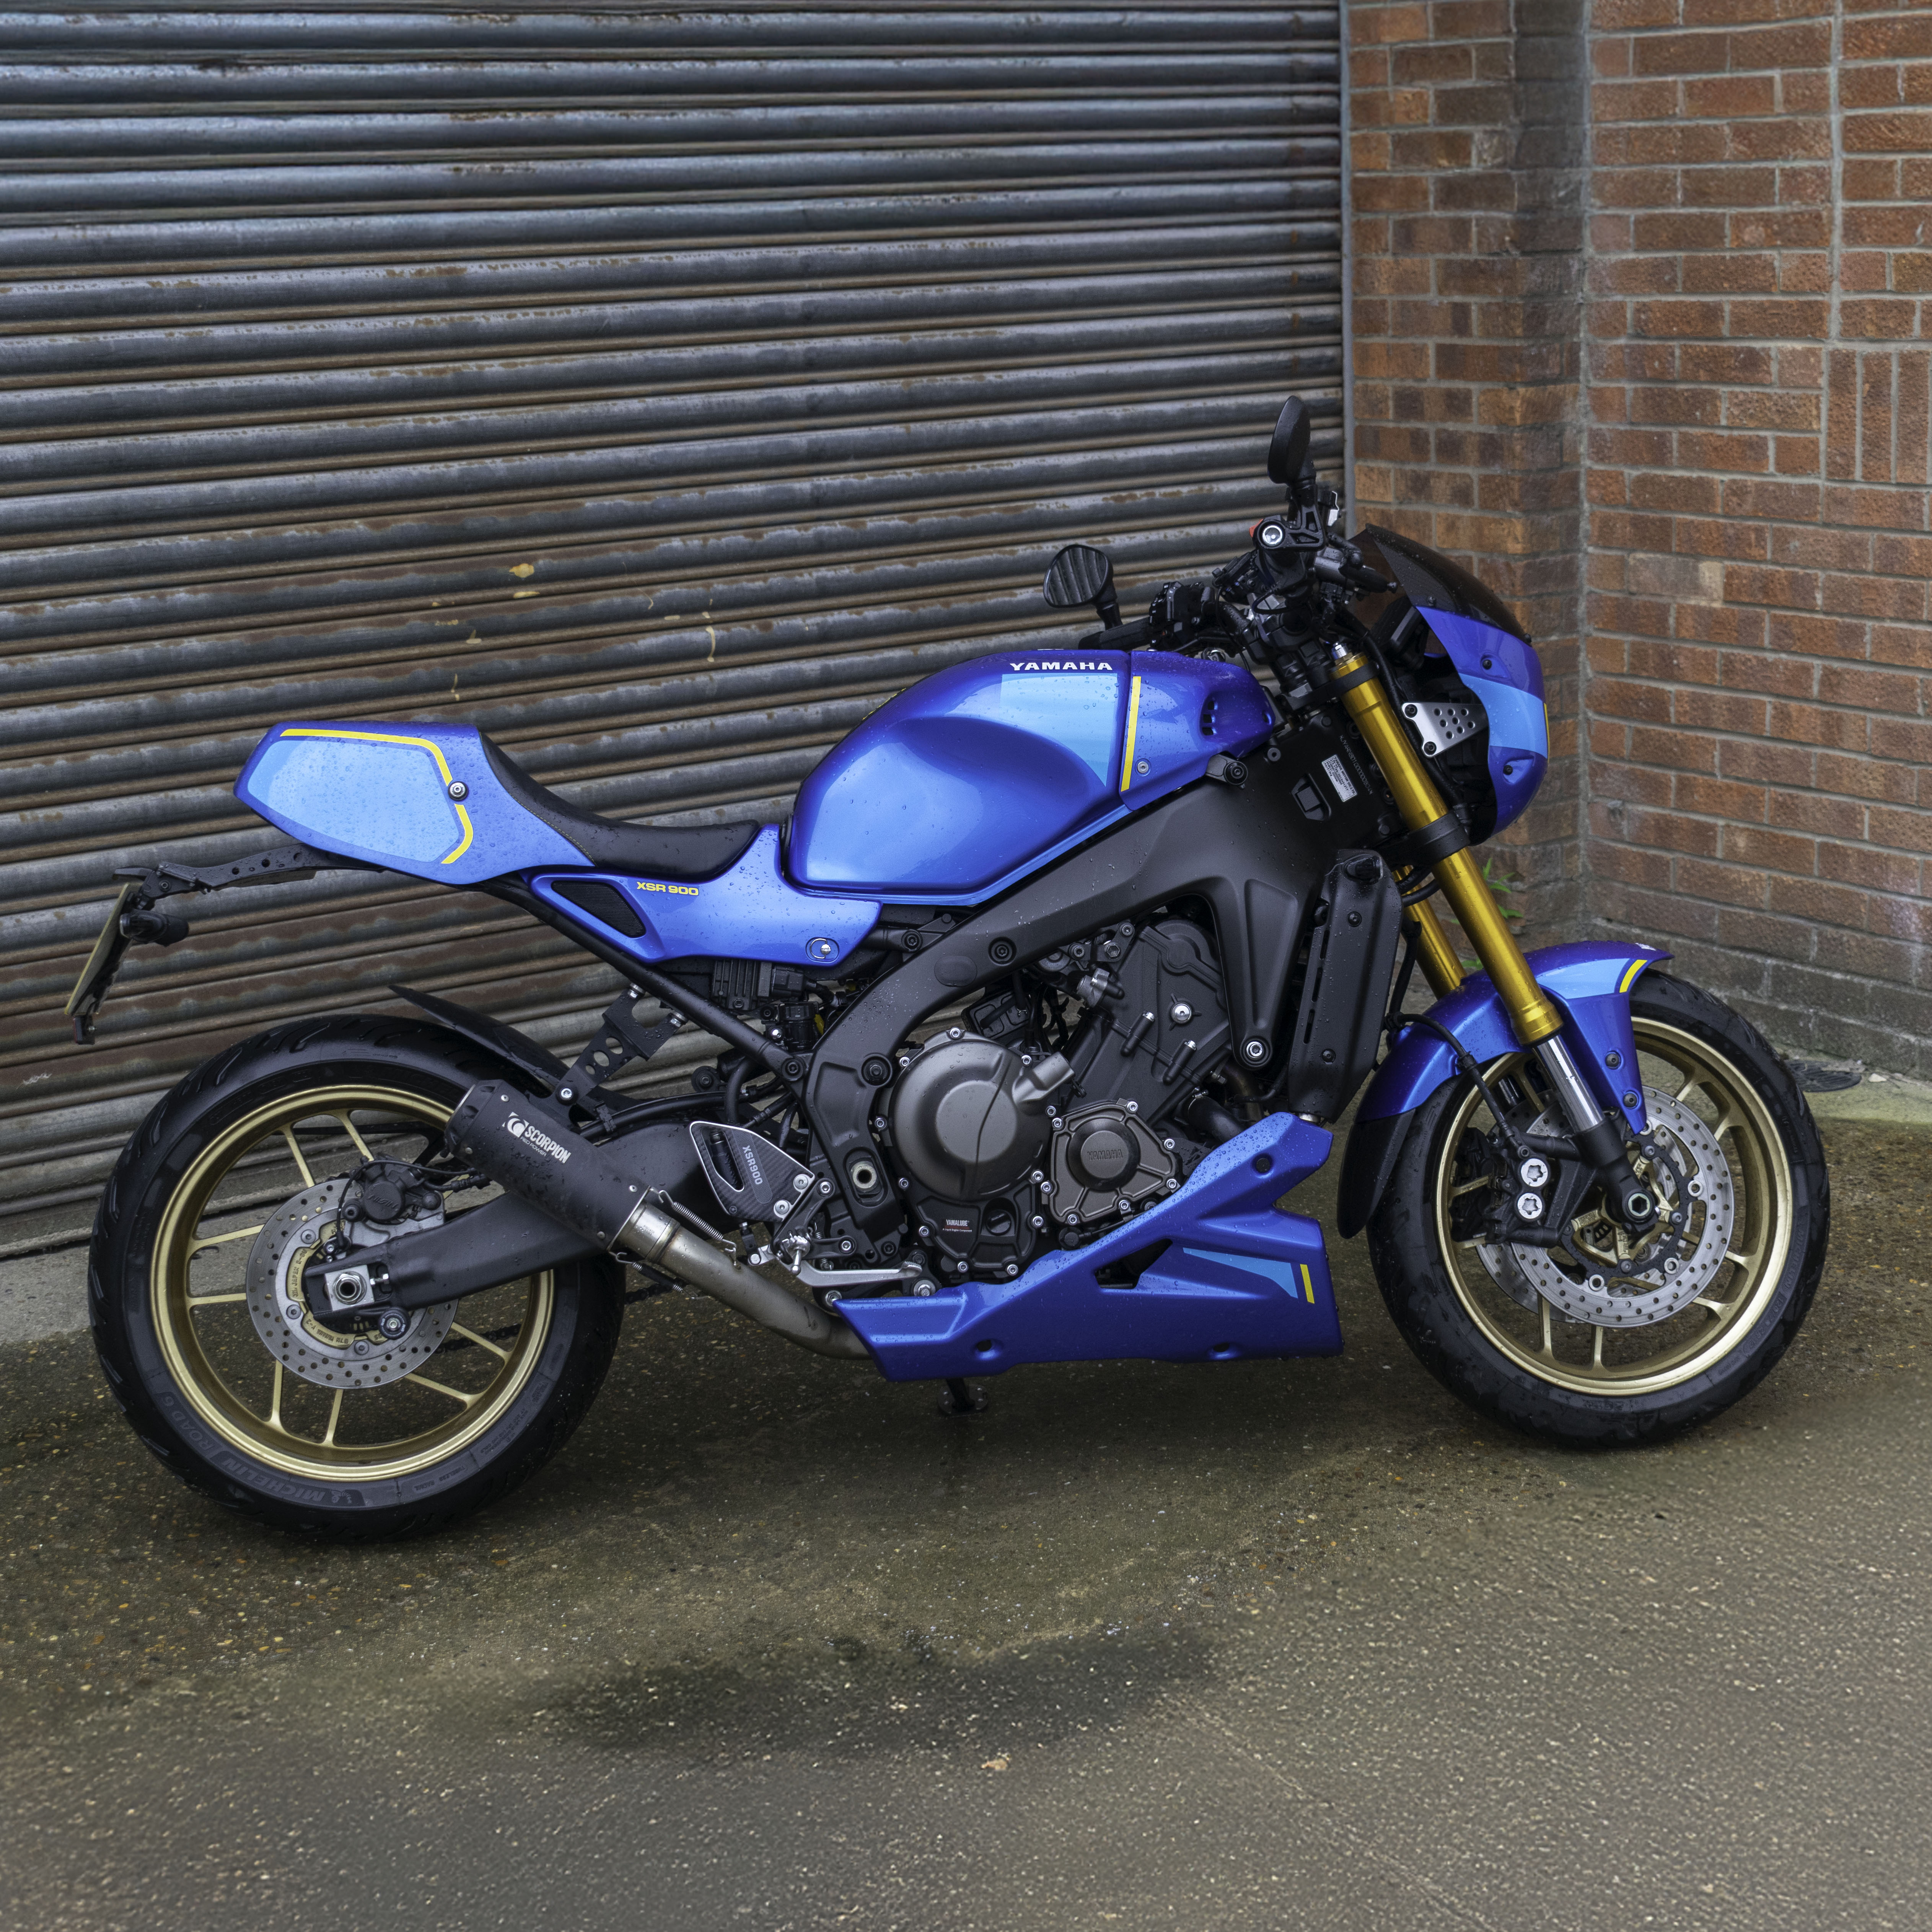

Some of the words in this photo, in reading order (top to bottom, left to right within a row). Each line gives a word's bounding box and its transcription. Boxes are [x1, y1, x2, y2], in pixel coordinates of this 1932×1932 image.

[1010, 662, 1113, 670] YAMAHA
[1334, 756, 1342, 770] YAMAHA
[1341, 771, 1349, 782] MOTOR
[637, 881, 666, 892] XSR
[668, 885, 699, 896] 900
[520, 1136, 531, 1145] RED
[529, 1142, 547, 1157] POWER
[524, 1124, 572, 1163] SCORPION
[1087, 1149, 1123, 1161] YAMAHA
[743, 1145, 763, 1185] XSR900
[161, 1394, 176, 1409] 6
[170, 1410, 214, 1452] ROAD
[220, 1457, 325, 1503] MICHELIN
